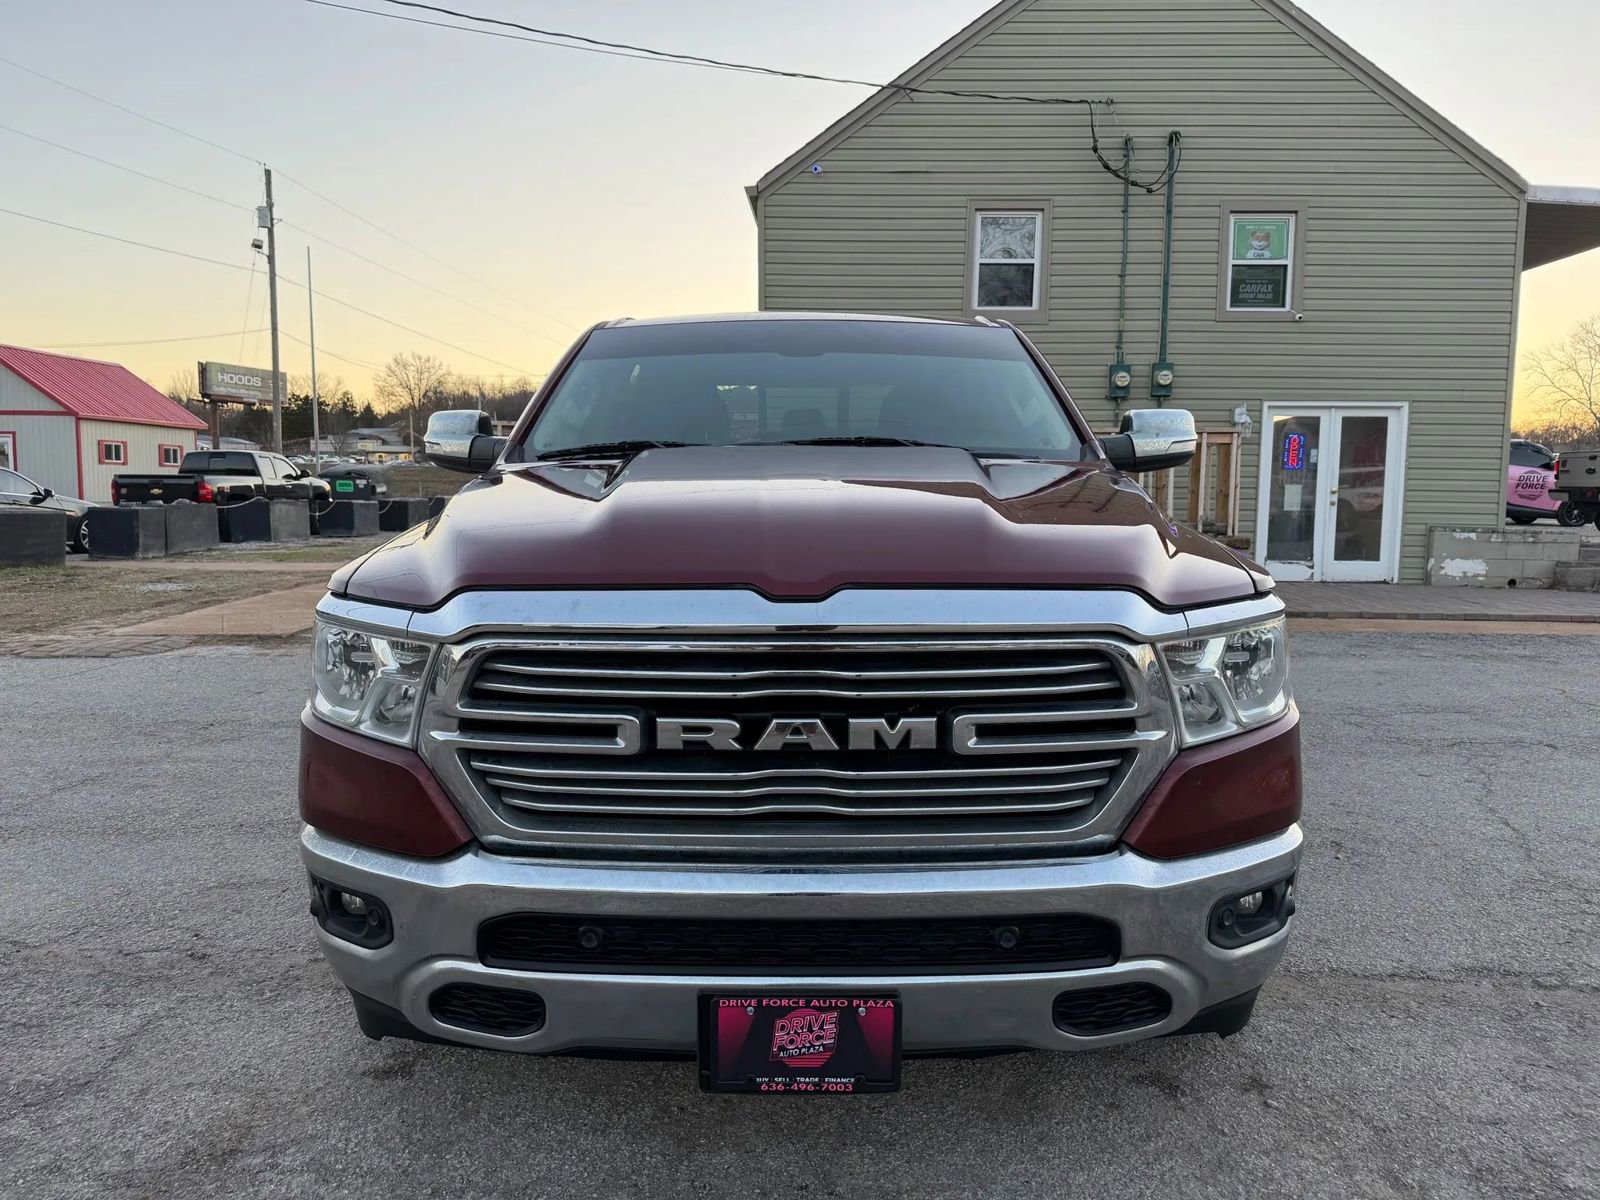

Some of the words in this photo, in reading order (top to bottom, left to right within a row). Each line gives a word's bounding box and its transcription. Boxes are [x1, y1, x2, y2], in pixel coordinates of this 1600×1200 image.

[1239, 284, 1273, 293] CARFAX
[217, 372, 262, 387] HOODS
[1289, 436, 1299, 467] OPEN
[1518, 475, 1549, 483] DRIVE
[1515, 482, 1547, 490] FORCE
[656, 717, 937, 750] RAM
[719, 999, 758, 1007] DRIVE
[762, 999, 806, 1007] FORCE
[810, 999, 848, 1007] AUTO
[853, 999, 894, 1008] PLAZA
[774, 1012, 838, 1036] DRIVE
[773, 1028, 837, 1052] FORCE
[779, 1048, 800, 1057] AUTO
[801, 1046, 824, 1055] PLAZA
[760, 1083, 853, 1092] 636-496-7003
